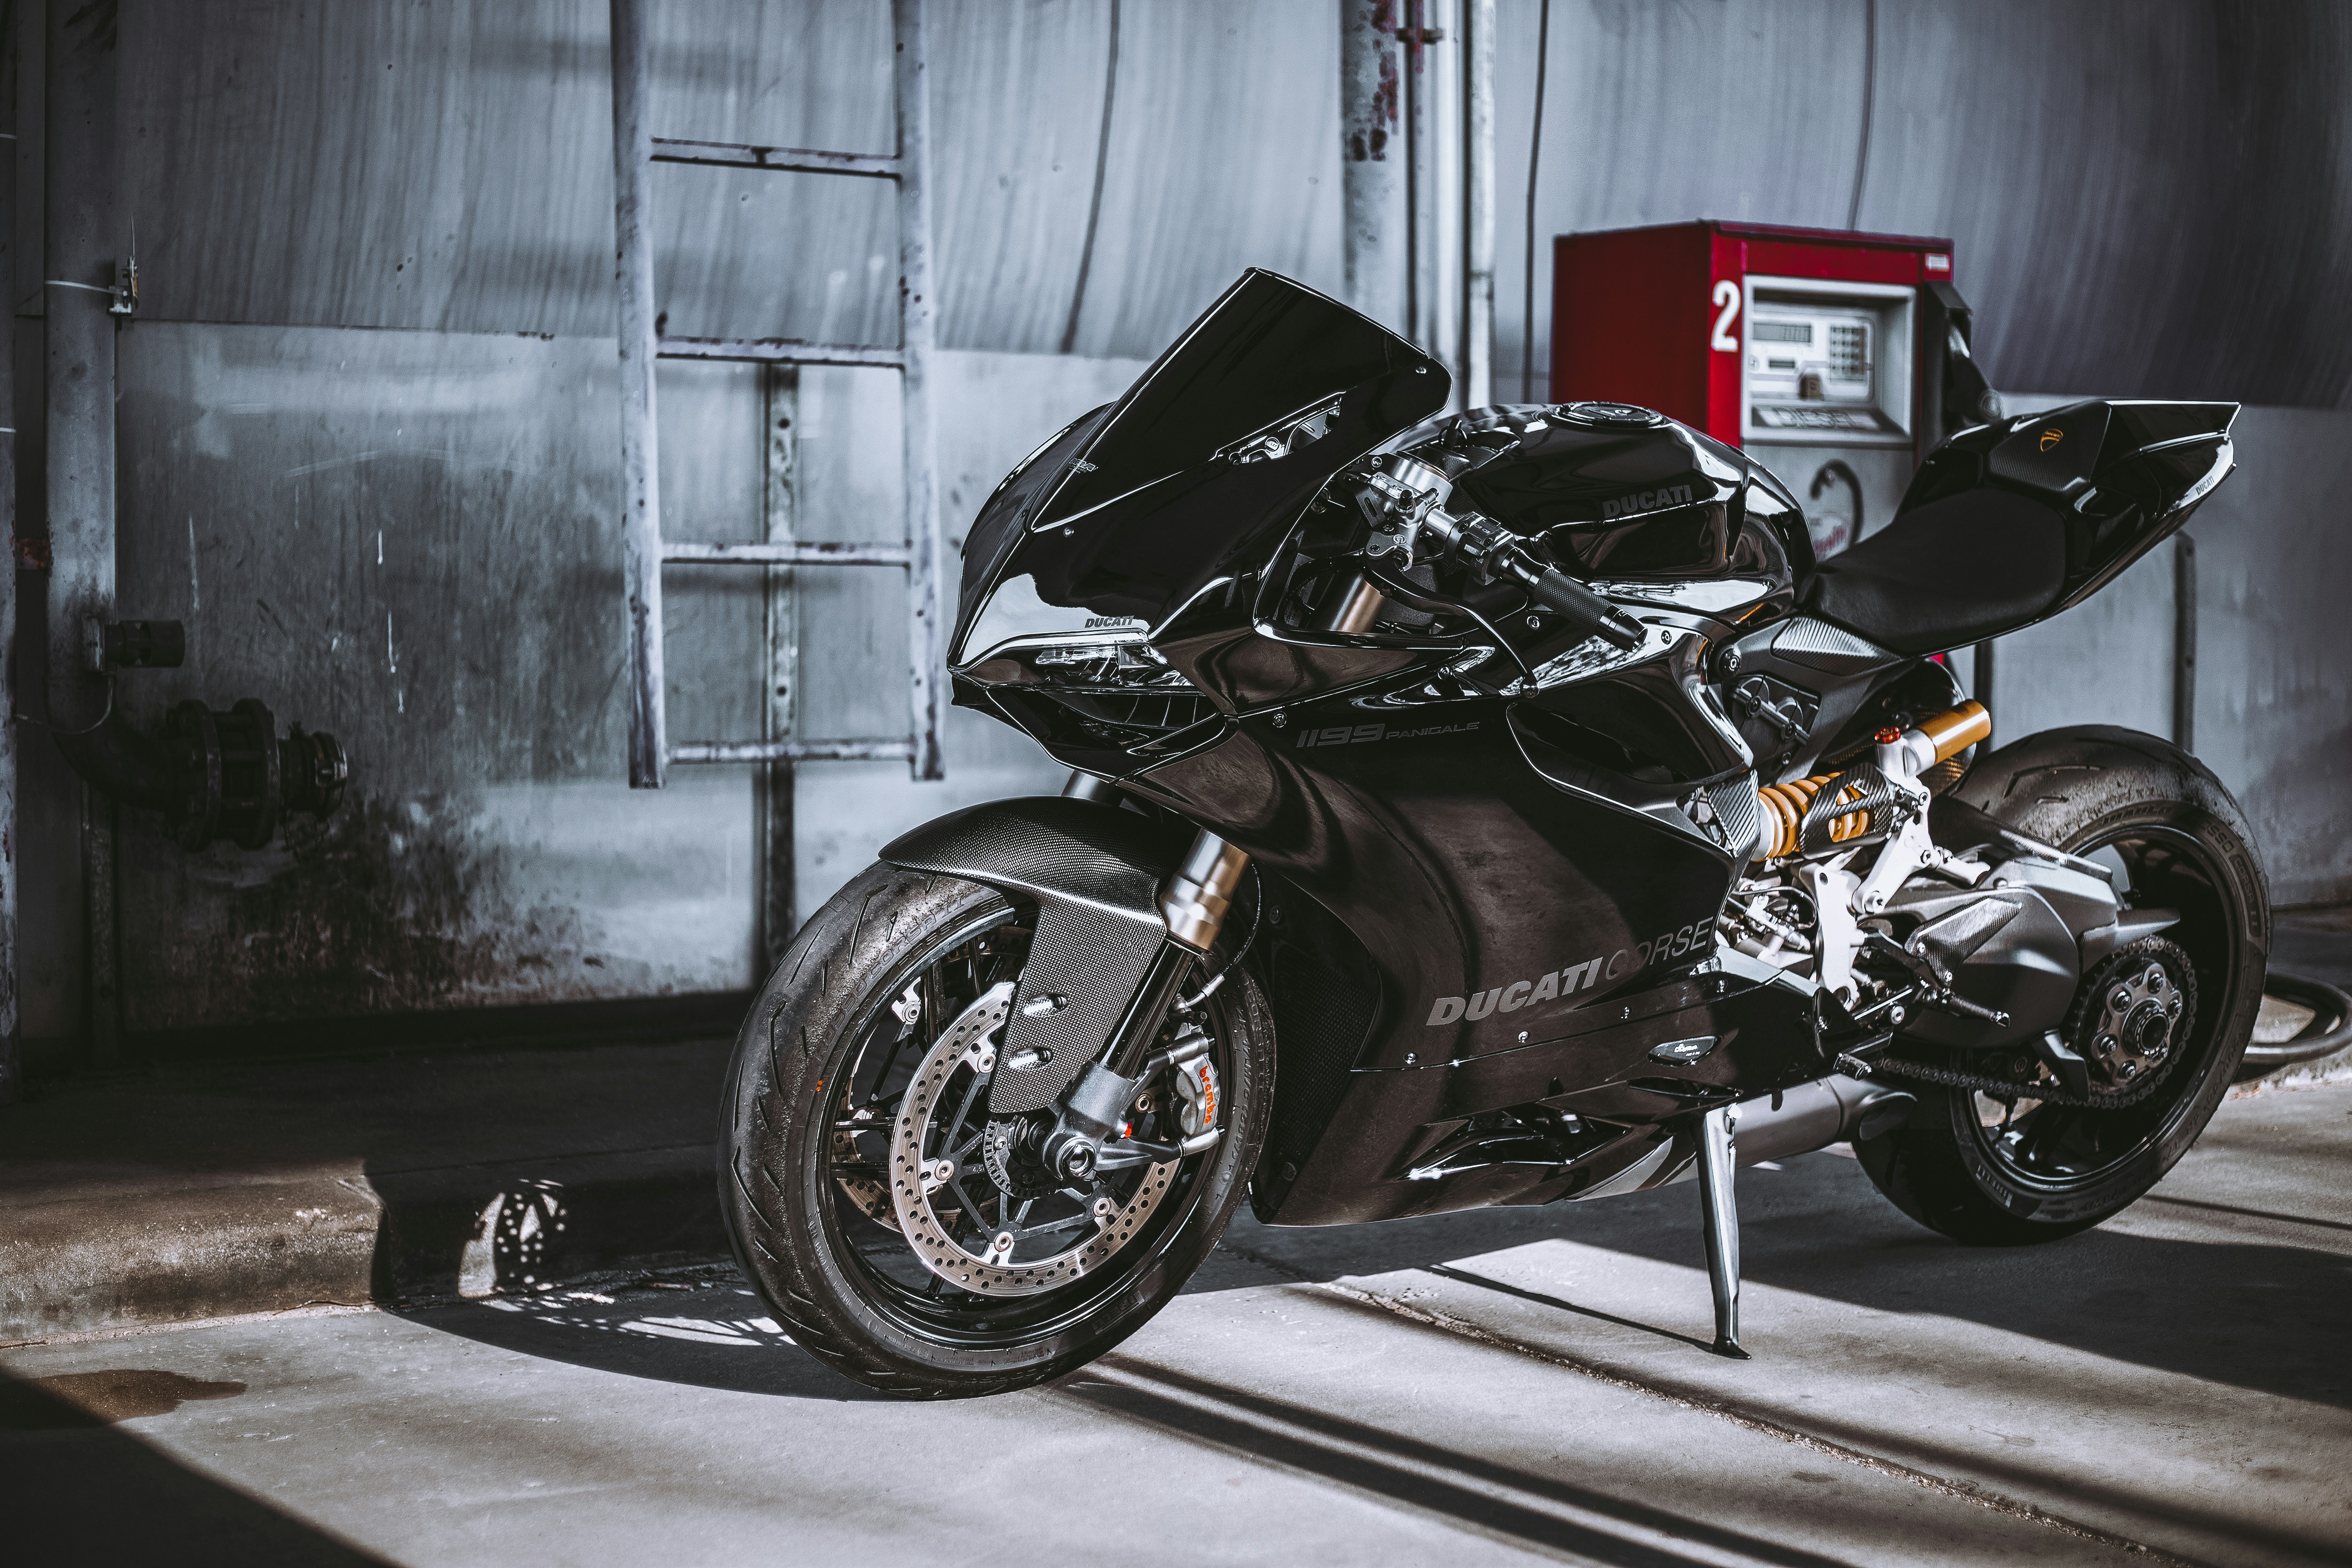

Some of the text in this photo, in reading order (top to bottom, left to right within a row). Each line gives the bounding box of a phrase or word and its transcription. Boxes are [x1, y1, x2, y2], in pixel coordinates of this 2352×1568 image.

[1710, 279, 1741, 352] 2
[1602, 484, 1693, 518] DUCATI
[2195, 475, 2215, 496] DUCATI
[1084, 615, 1134, 629] DUCATI
[1296, 721, 1480, 748] 1199 PANIGALE
[815, 979, 867, 1062] ROSSO
[870, 912, 937, 979] CORSA
[1425, 915, 1714, 1026] DUCATI CORSE
[819, 998, 872, 1093] DIABLO
[897, 914, 967, 971] ROSSO
[1199, 1065, 1216, 1125] brembo
[1091, 1290, 1145, 1335] PIRELLI
